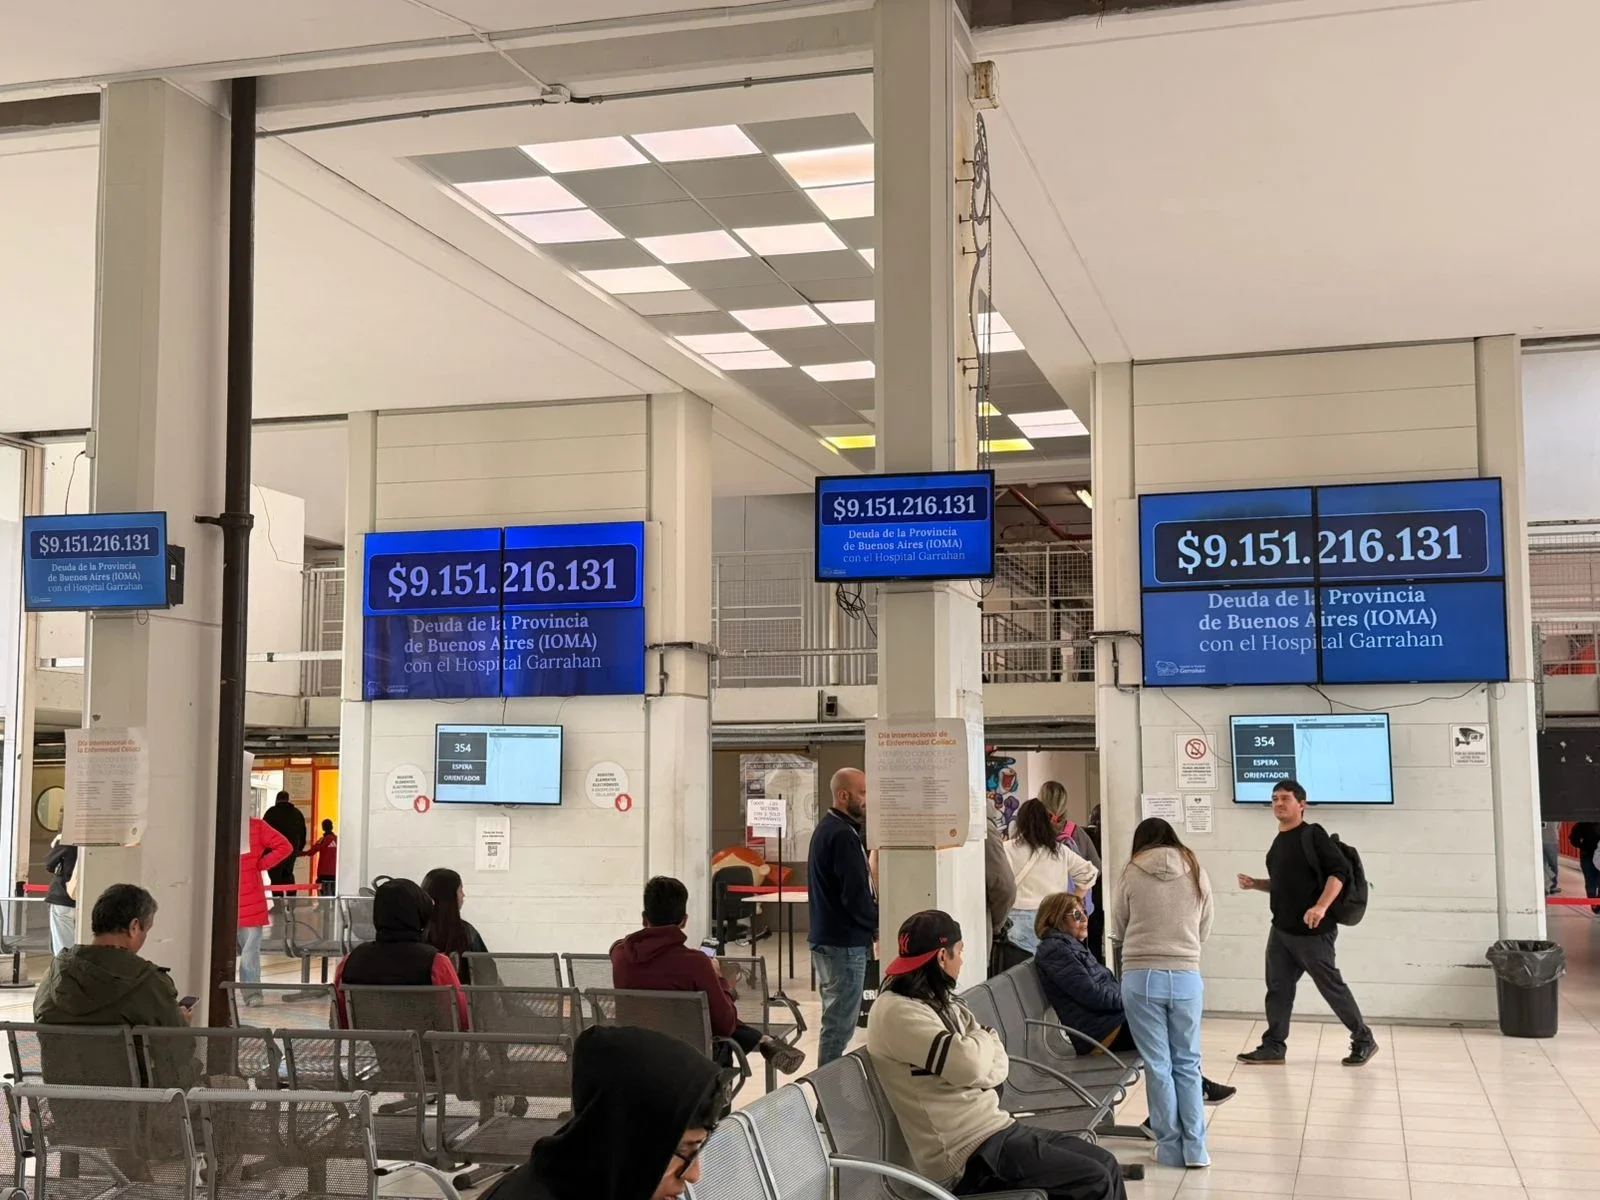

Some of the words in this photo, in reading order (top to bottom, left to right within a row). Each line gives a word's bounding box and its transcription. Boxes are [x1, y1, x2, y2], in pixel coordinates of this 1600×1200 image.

[833, 494, 976, 521] $9.151.216.131
[848, 529, 880, 539] Deuda
[882, 528, 894, 538] de
[897, 528, 906, 537] la
[909, 526, 958, 537] Provincia
[39, 534, 151, 556] $9.151.216.131
[843, 542, 855, 551] de
[858, 541, 894, 551] Buenos
[897, 540, 923, 550] Aires
[926, 538, 963, 550] (IOMA)
[1177, 524, 1462, 574] $9.151.216.131
[843, 554, 861, 563] con
[863, 553, 873, 563] el
[875, 552, 916, 565] Hospital
[918, 551, 965, 562] Garrahan
[52, 563, 76, 572] Deuda
[78, 562, 88, 571] de
[90, 562, 97, 571] la
[98, 561, 136, 571] Provincia
[47, 573, 58, 582] de
[59, 572, 88, 582] Buenos
[90, 572, 110, 582] Aires
[112, 571, 141, 583] (IOMA)
[388, 558, 617, 603] $9.151.216.131
[48, 584, 63, 593] con
[64, 584, 72, 593] el
[73, 583, 105, 594] Hospital
[107, 582, 143, 592] Garrahan
[1207, 592, 1270, 609] Deuda
[1275, 590, 1298, 608] de
[1328, 585, 1426, 605] Provincia
[413, 616, 463, 633] Deuda
[467, 614, 487, 631] de
[491, 614, 505, 631] la
[511, 613, 589, 631] Provincia
[1199, 614, 1221, 631] de
[1227, 612, 1299, 630] Buenos
[1305, 610, 1358, 629] Aires
[1363, 607, 1437, 630] (IOMA)
[404, 637, 423, 653] de
[427, 637, 486, 653] Buenos
[491, 635, 534, 651] Aires
[538, 632, 597, 653] (IOMA)
[1199, 636, 1234, 653] con
[1239, 634, 1256, 652] el
[1262, 631, 1343, 656] Hospital
[1349, 629, 1444, 649] Garrahan
[404, 660, 432, 674] con
[437, 657, 450, 672] el
[455, 655, 522, 676] Hospital
[526, 653, 602, 670] Garrahan
[891, 731, 937, 739] Internacional
[1253, 735, 1275, 747] 354
[454, 743, 471, 753] 354
[886, 739, 929, 747] Enfermedad
[451, 763, 473, 771] ESPERA
[1253, 758, 1279, 767] ESPERA
[443, 774, 481, 782] ORIENTADOR
[1243, 770, 1289, 780] ORIENTADOR
